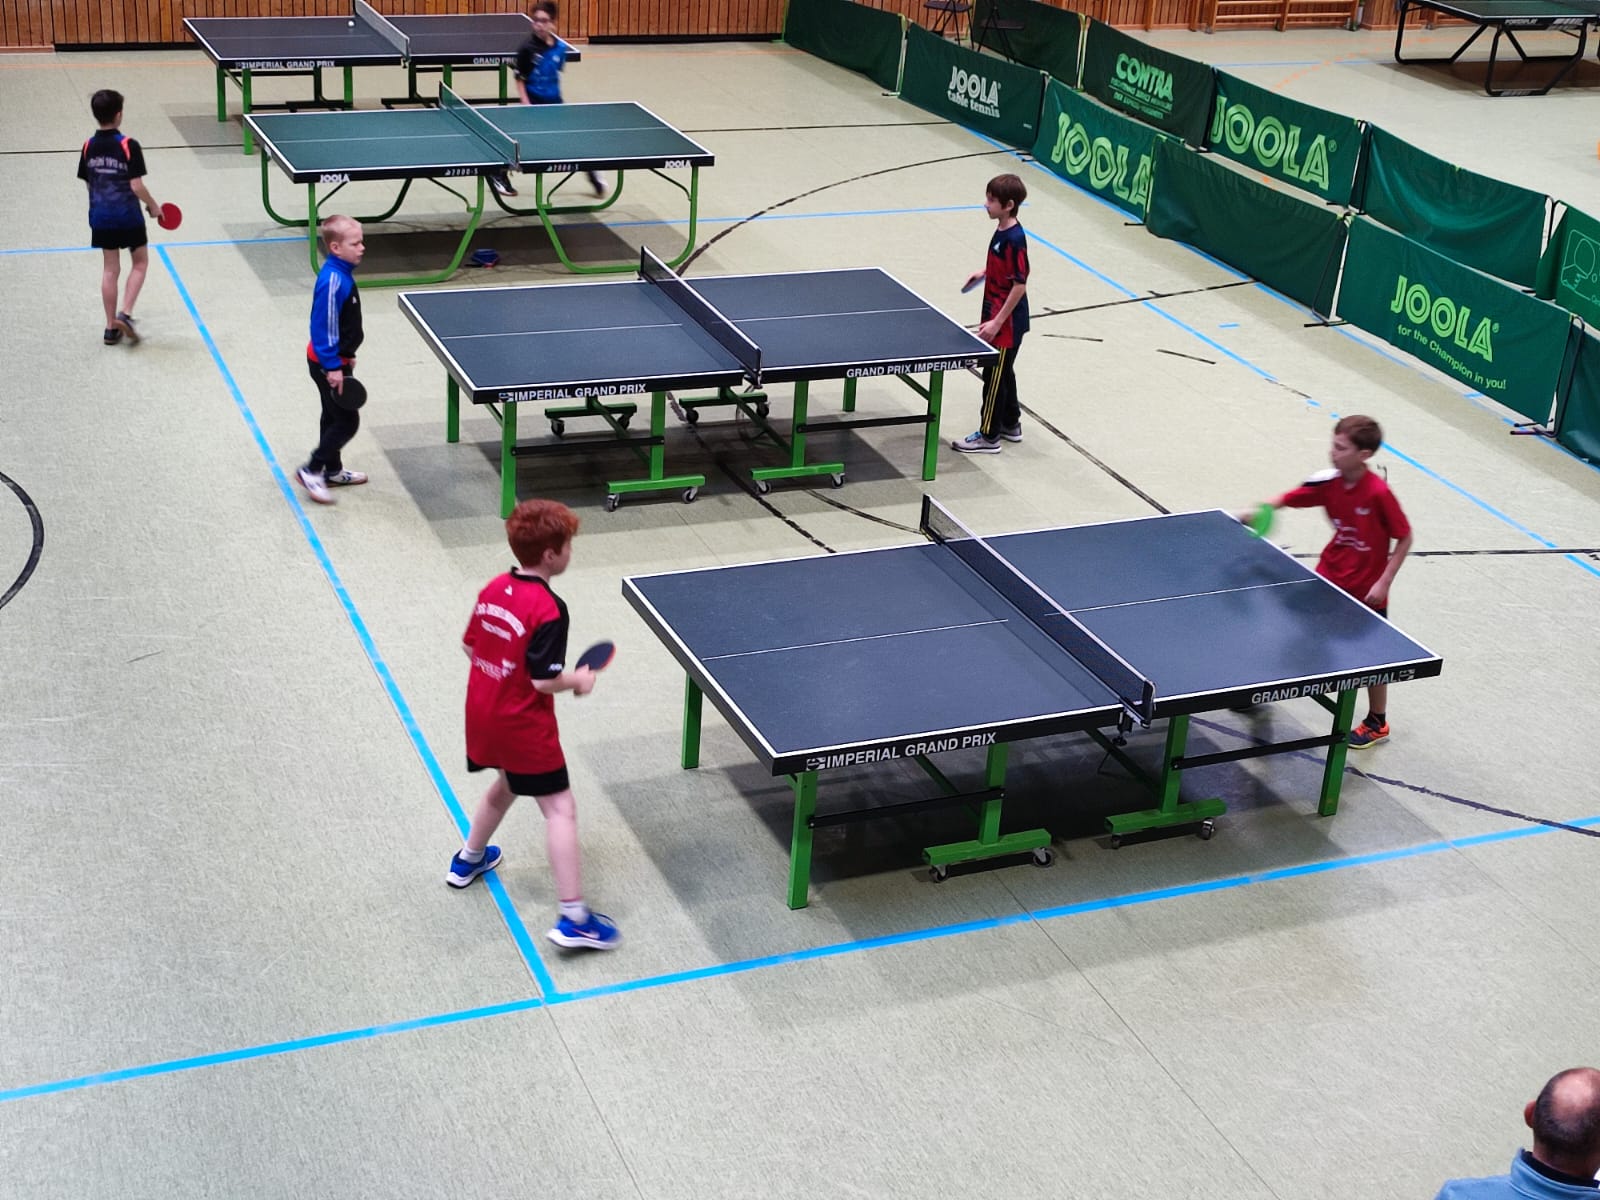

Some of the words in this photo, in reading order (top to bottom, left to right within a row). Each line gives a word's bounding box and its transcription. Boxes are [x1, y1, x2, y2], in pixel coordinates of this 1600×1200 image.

[245, 61, 283, 70] IMPERIAL
[286, 60, 315, 69] GRAND
[316, 60, 335, 68] PRIX
[1116, 53, 1173, 102] CONTRA
[949, 65, 999, 107] JOOLA
[947, 90, 969, 108] table
[970, 99, 1000, 118] tennis
[1051, 112, 1151, 206] JOOLA
[1210, 95, 1329, 191] JOOLA
[320, 174, 350, 183] JOOLA
[664, 160, 692, 169] JOOLA
[1390, 275, 1493, 363] JOOLA
[846, 366, 885, 378] GRAND
[887, 364, 912, 375] PRIX
[914, 360, 964, 372] IMPERIAL
[1398, 324, 1412, 337] for
[1413, 329, 1428, 345] the
[1429, 341, 1473, 380] Champion
[1474, 372, 1484, 384] in
[1485, 378, 1507, 390] you!
[514, 388, 572, 401] IMPERIAL
[575, 385, 617, 397] GRAND
[619, 383, 646, 394] PRIX
[1251, 687, 1300, 704] GRAND
[1302, 681, 1334, 697] PRIX
[1336, 671, 1399, 692] IMPERIAL
[826, 746, 901, 769] IMPERIAL
[904, 738, 959, 757] GRAND
[961, 731, 997, 749] PRIX
